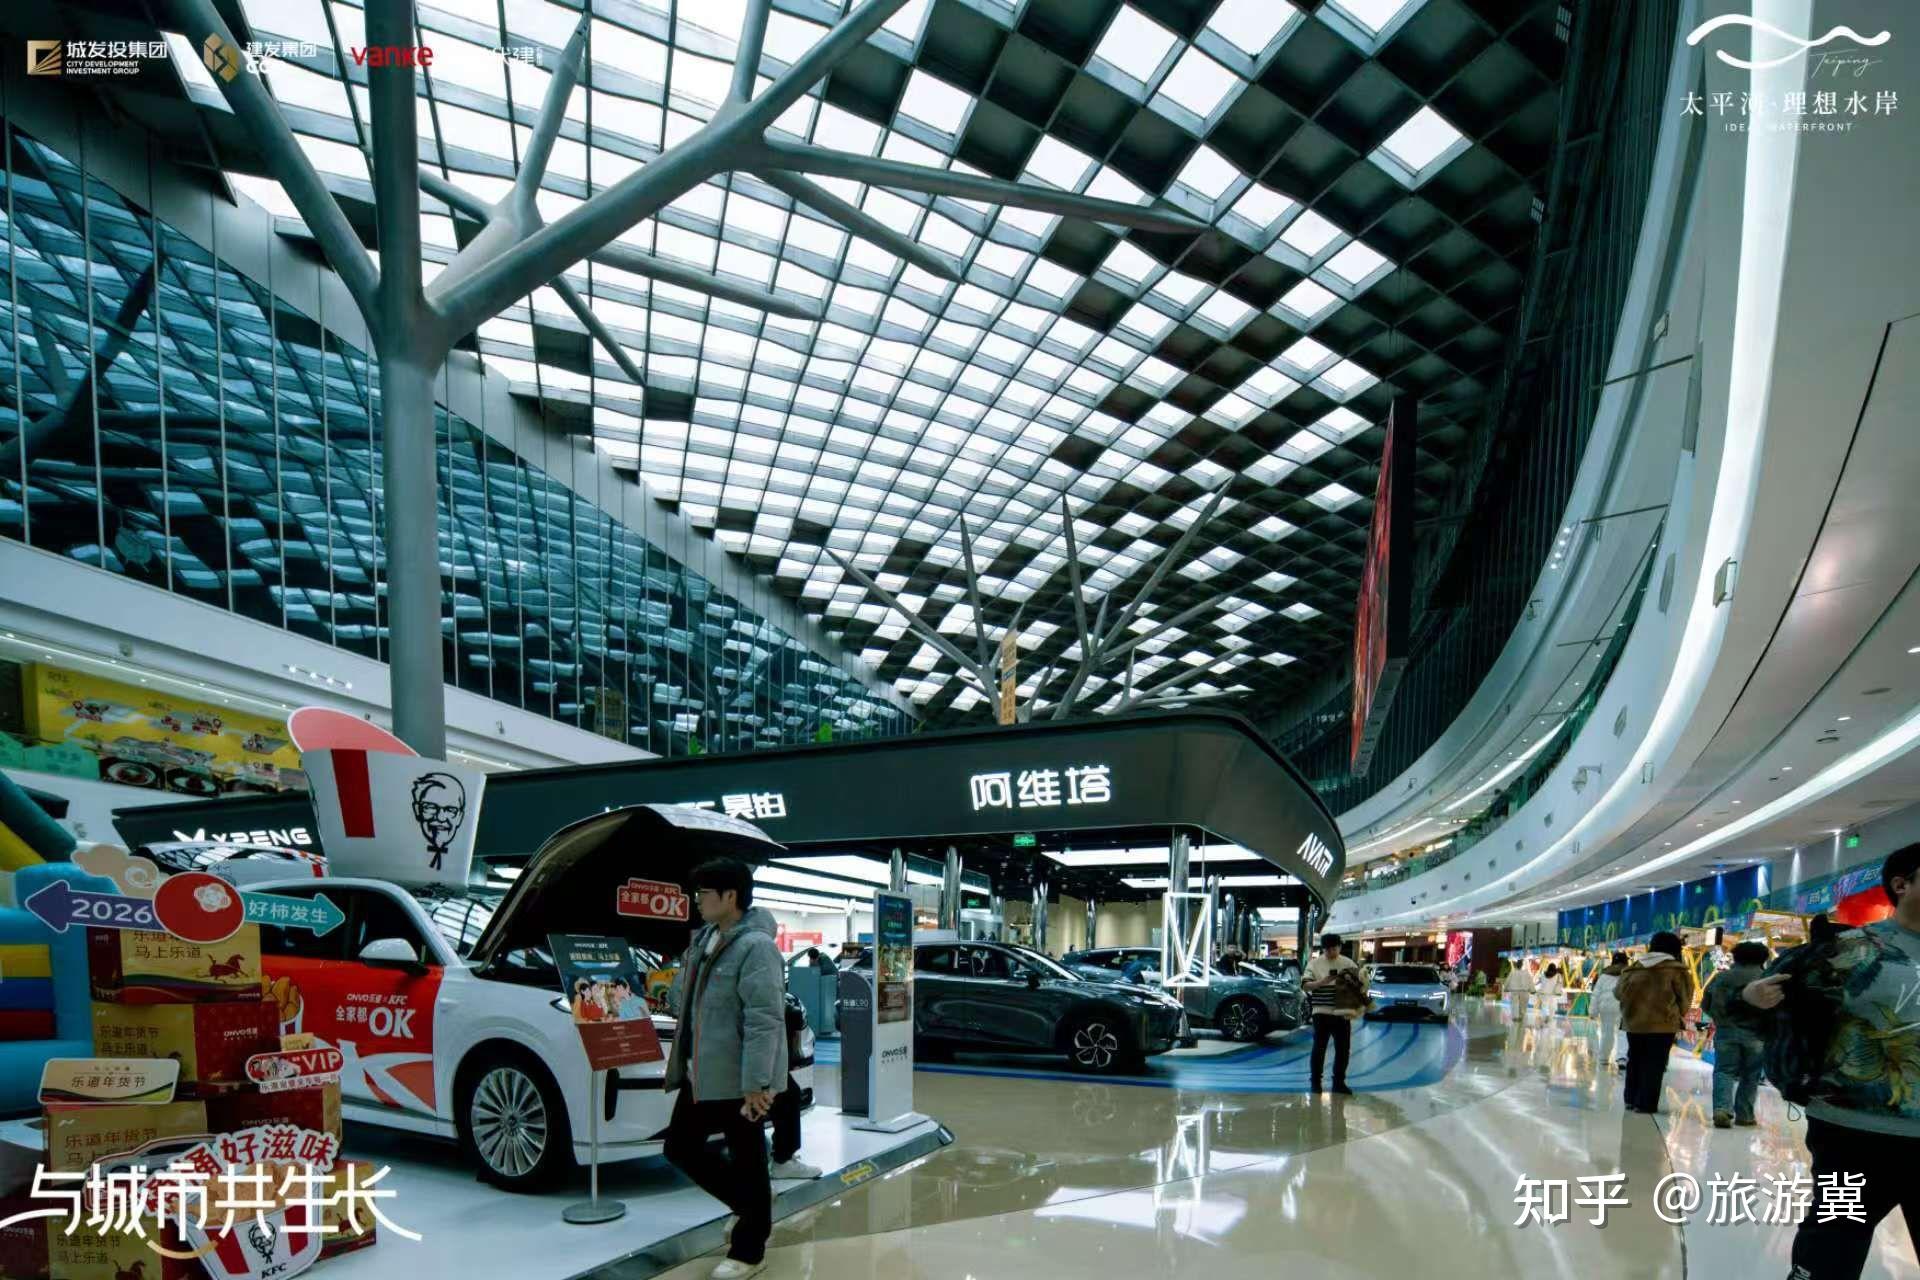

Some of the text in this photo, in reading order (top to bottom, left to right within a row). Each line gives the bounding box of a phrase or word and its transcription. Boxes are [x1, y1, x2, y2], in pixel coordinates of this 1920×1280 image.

[970, 765, 1111, 811] 阿维塔
[71, 898, 153, 924] 2026
[248, 899, 328, 925] 好柿发生
[649, 894, 686, 917] OK
[388, 994, 408, 1006] KFC
[368, 1006, 416, 1039] OK
[302, 1051, 340, 1072] VIP
[71, 1075, 146, 1089] 乐道年货节
[261, 1263, 288, 1280] KFC
